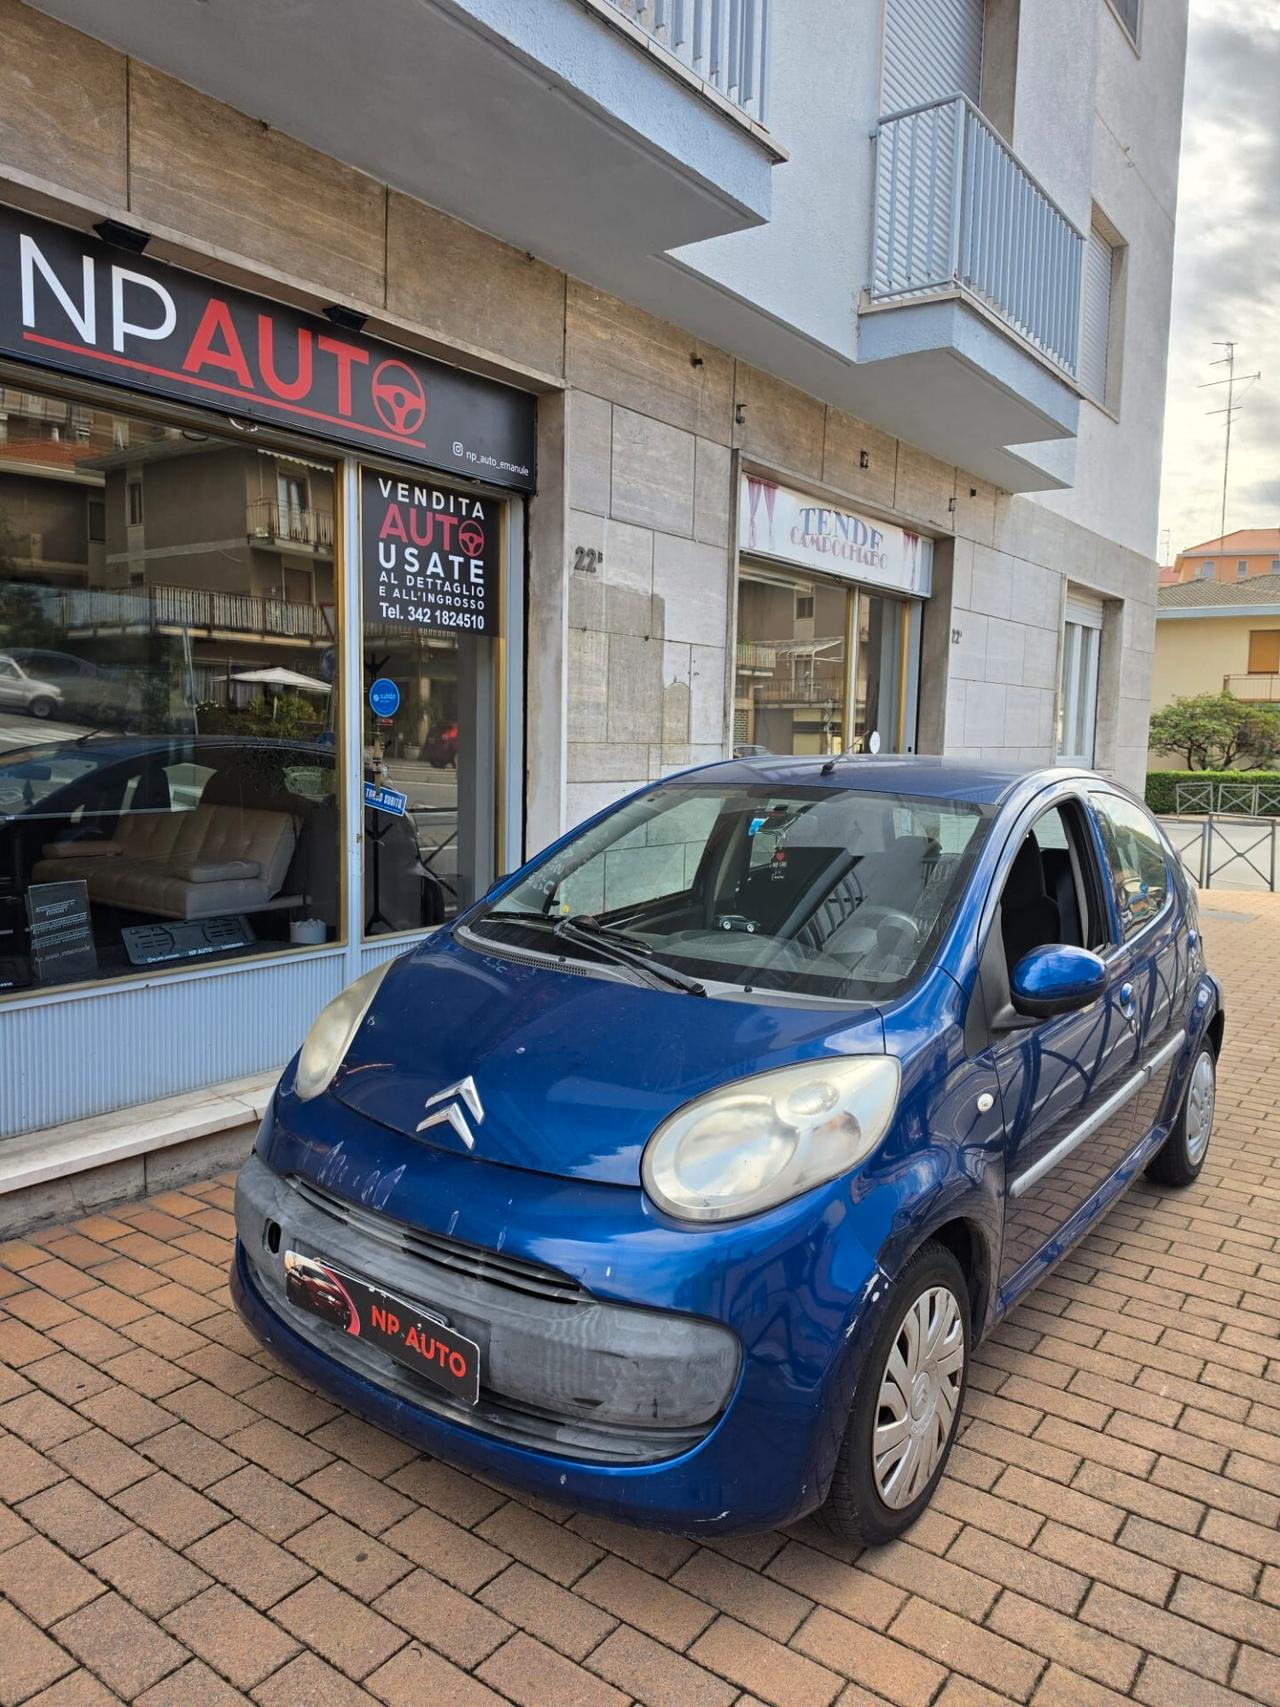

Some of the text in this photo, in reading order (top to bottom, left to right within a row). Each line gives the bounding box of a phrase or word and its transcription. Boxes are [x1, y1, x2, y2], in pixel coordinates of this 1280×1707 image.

[378, 477, 485, 521] VENDITA
[379, 502, 485, 558] AUTO
[378, 541, 484, 585] USATE
[379, 570, 485, 598] AL DETTAGLIO
[379, 585, 485, 611] E ALL'INGROSSO
[379, 602, 485, 630] Tel. 342 1824510
[370, 1305, 467, 1378] NP AUTO
